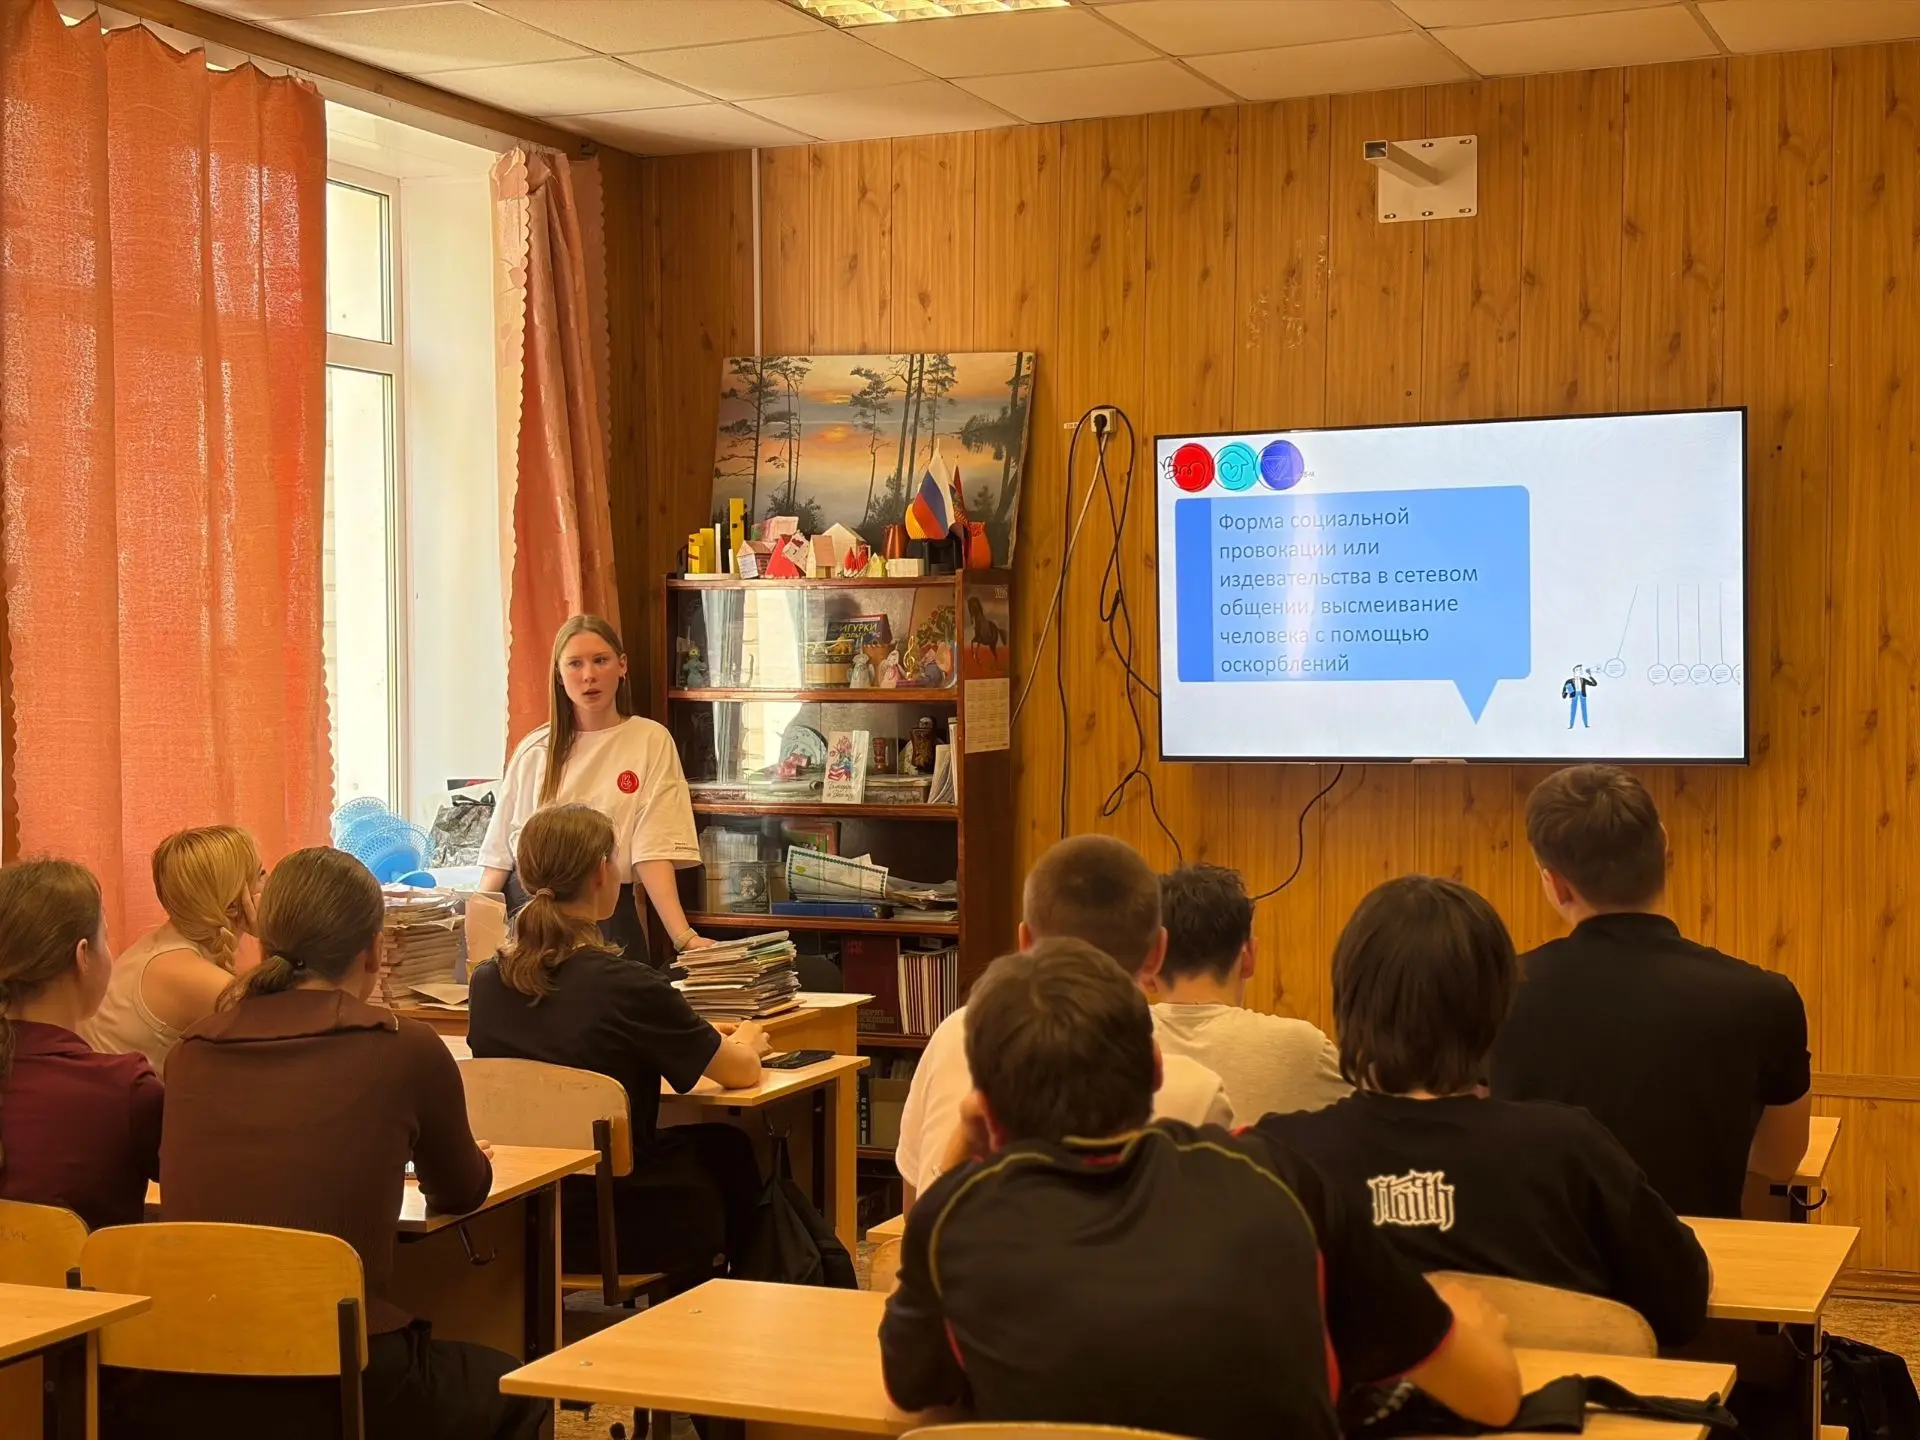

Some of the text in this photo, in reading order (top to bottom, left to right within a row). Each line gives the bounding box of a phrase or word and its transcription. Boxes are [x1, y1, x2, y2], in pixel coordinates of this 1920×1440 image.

[1219, 507, 1409, 533] Форма социальной
[1220, 542, 1379, 562] провокации или
[1220, 568, 1478, 590] издевательства в сетевом
[1321, 598, 1458, 614] высмеивание
[1220, 628, 1429, 645] человека с помощью
[1221, 653, 1349, 675] оскорблений
